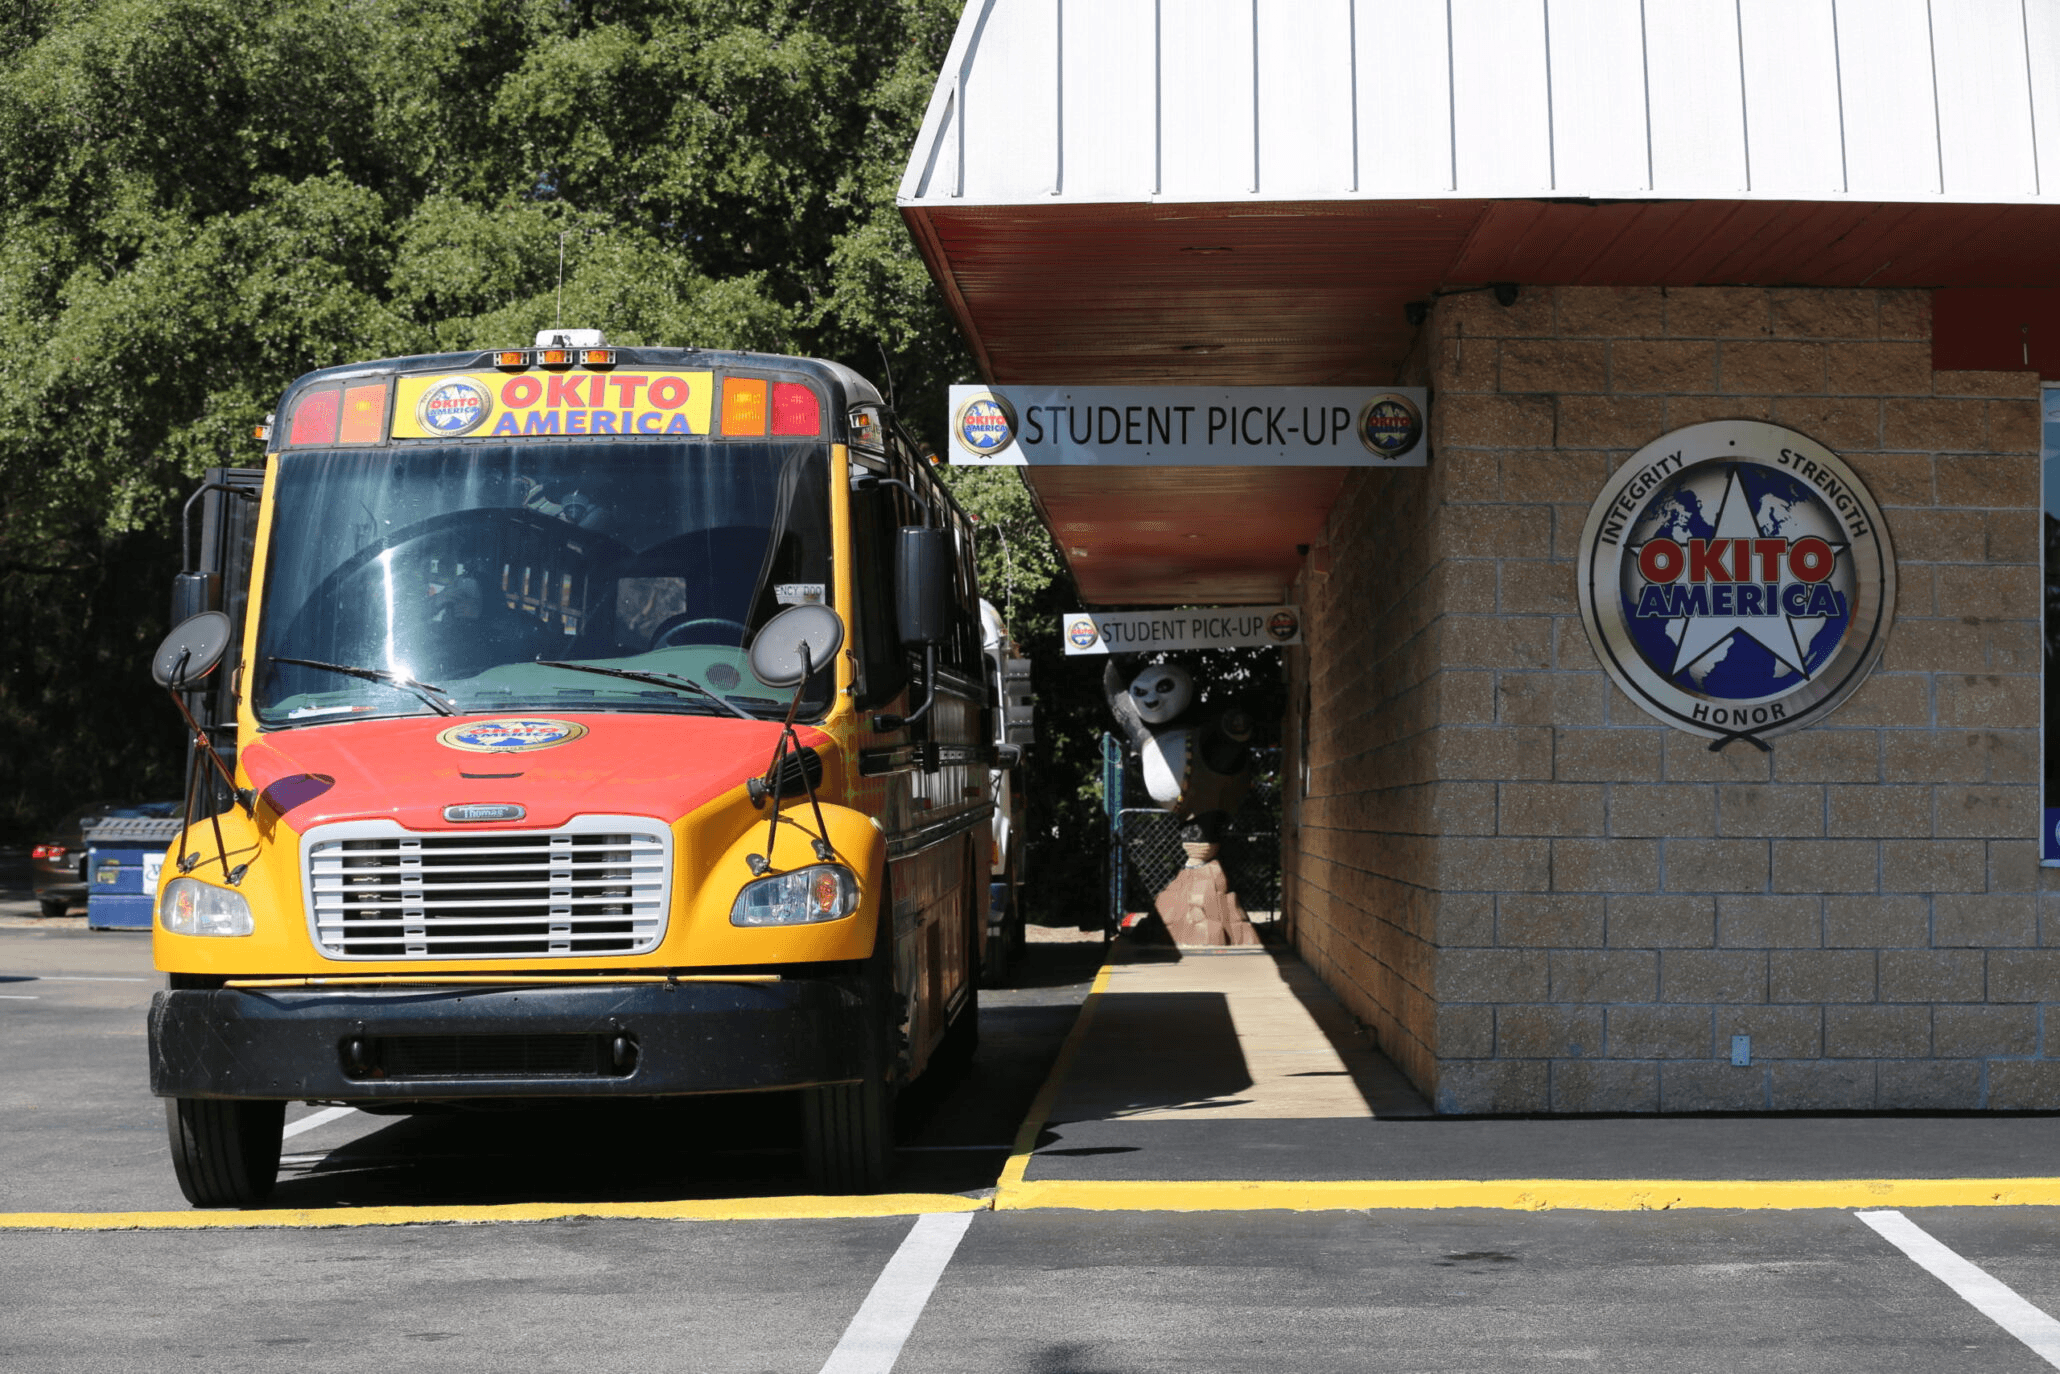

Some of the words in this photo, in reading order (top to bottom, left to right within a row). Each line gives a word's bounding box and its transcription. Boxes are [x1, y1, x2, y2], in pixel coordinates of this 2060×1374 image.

[430, 397, 478, 409] OKITO
[501, 375, 690, 410] OKITO
[490, 410, 692, 436] AMERICA
[965, 415, 1008, 425] OKITO
[1025, 406, 1196, 446] STUDENT
[1207, 406, 1351, 446] PICK-UP
[1602, 451, 1683, 545] INTEGRITY
[1777, 448, 1869, 538] STRENGTH
[1637, 536, 1835, 584] OKITO
[1635, 583, 1840, 618] AMERICA
[1103, 620, 1187, 643] STUDENT
[1192, 617, 1264, 639] PICK-UP
[1692, 703, 1787, 725] HONOR
[459, 806, 508, 818] Thomas
